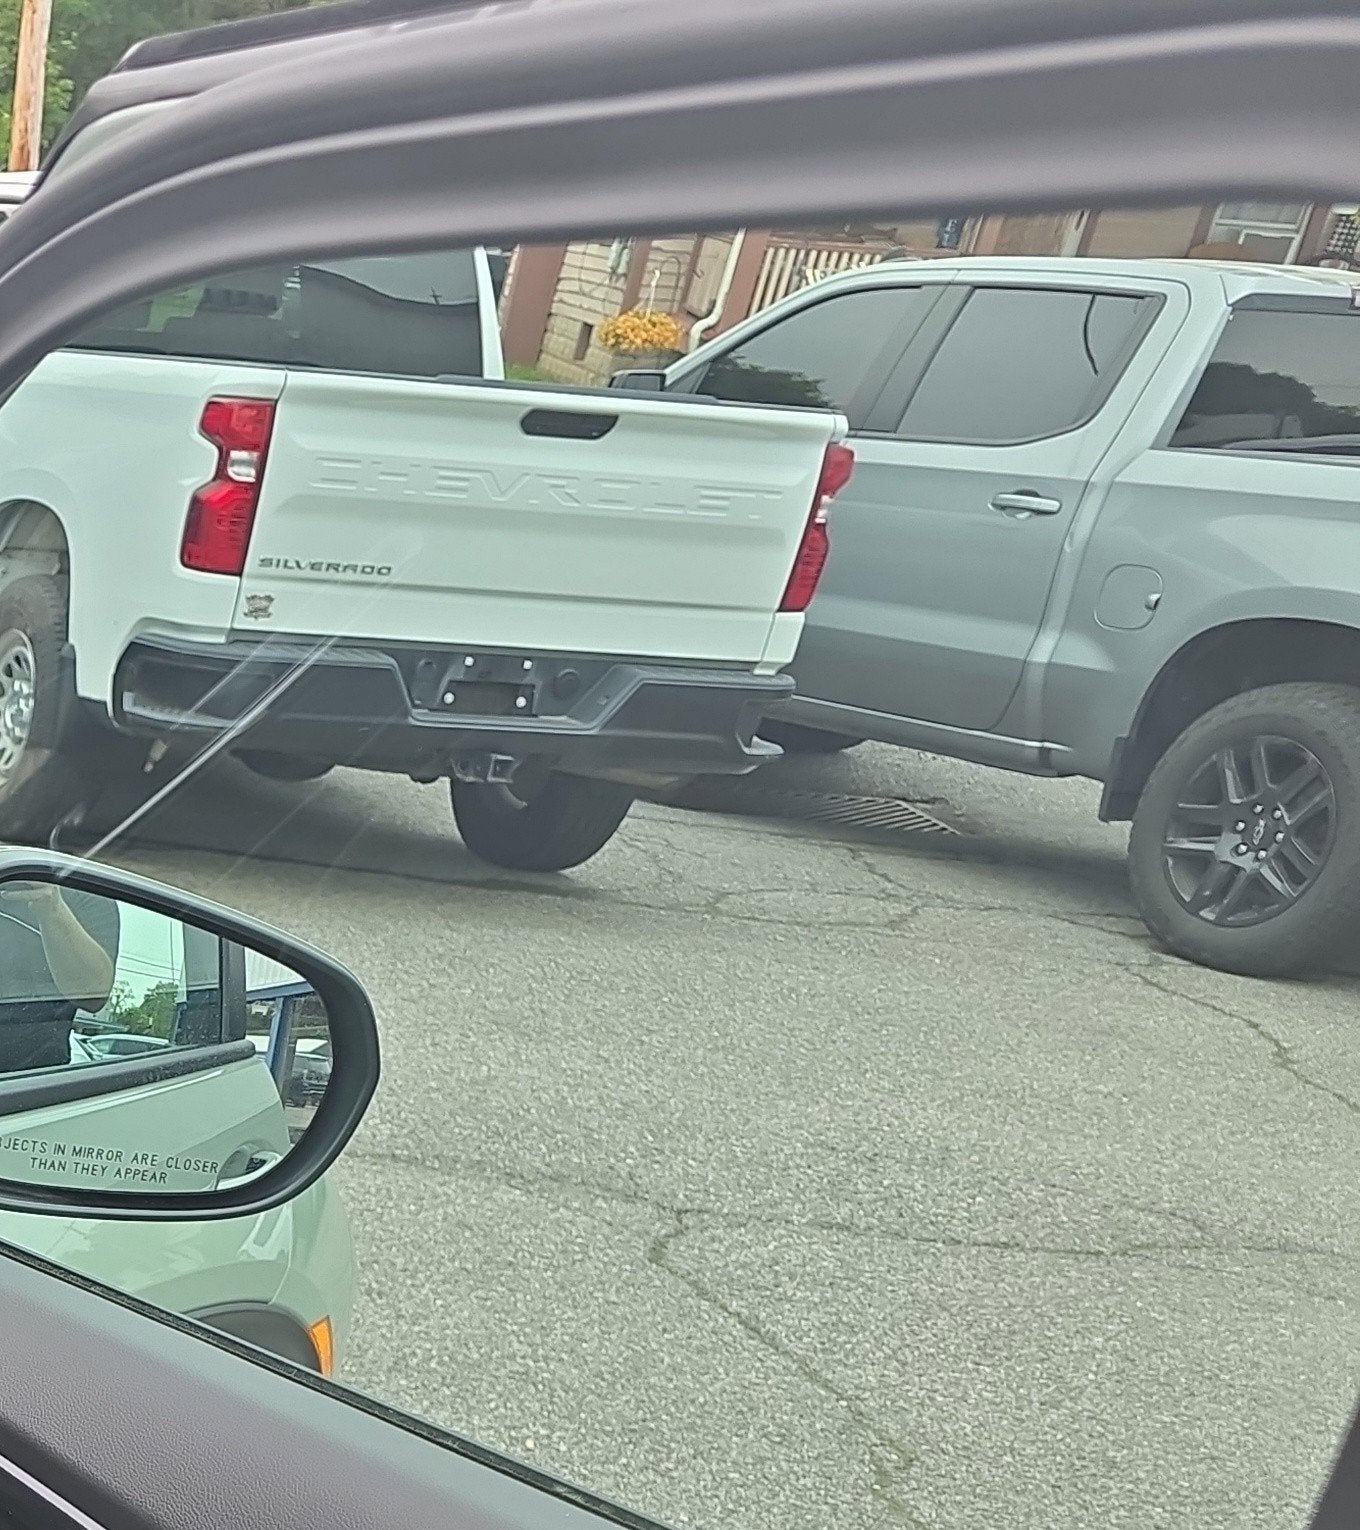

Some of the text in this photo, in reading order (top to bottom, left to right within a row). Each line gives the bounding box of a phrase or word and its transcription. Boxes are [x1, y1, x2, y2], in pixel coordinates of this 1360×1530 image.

[307, 456, 784, 521] CHEVROLET
[258, 556, 393, 577] SILVERADO
[30, 1156, 168, 1184] THAN THEY APPEAR
[52, 1142, 67, 1156] IN
[71, 1145, 124, 1164] MIRROR
[130, 1152, 159, 1167] ARE
[165, 1156, 219, 1174] CLOSER
